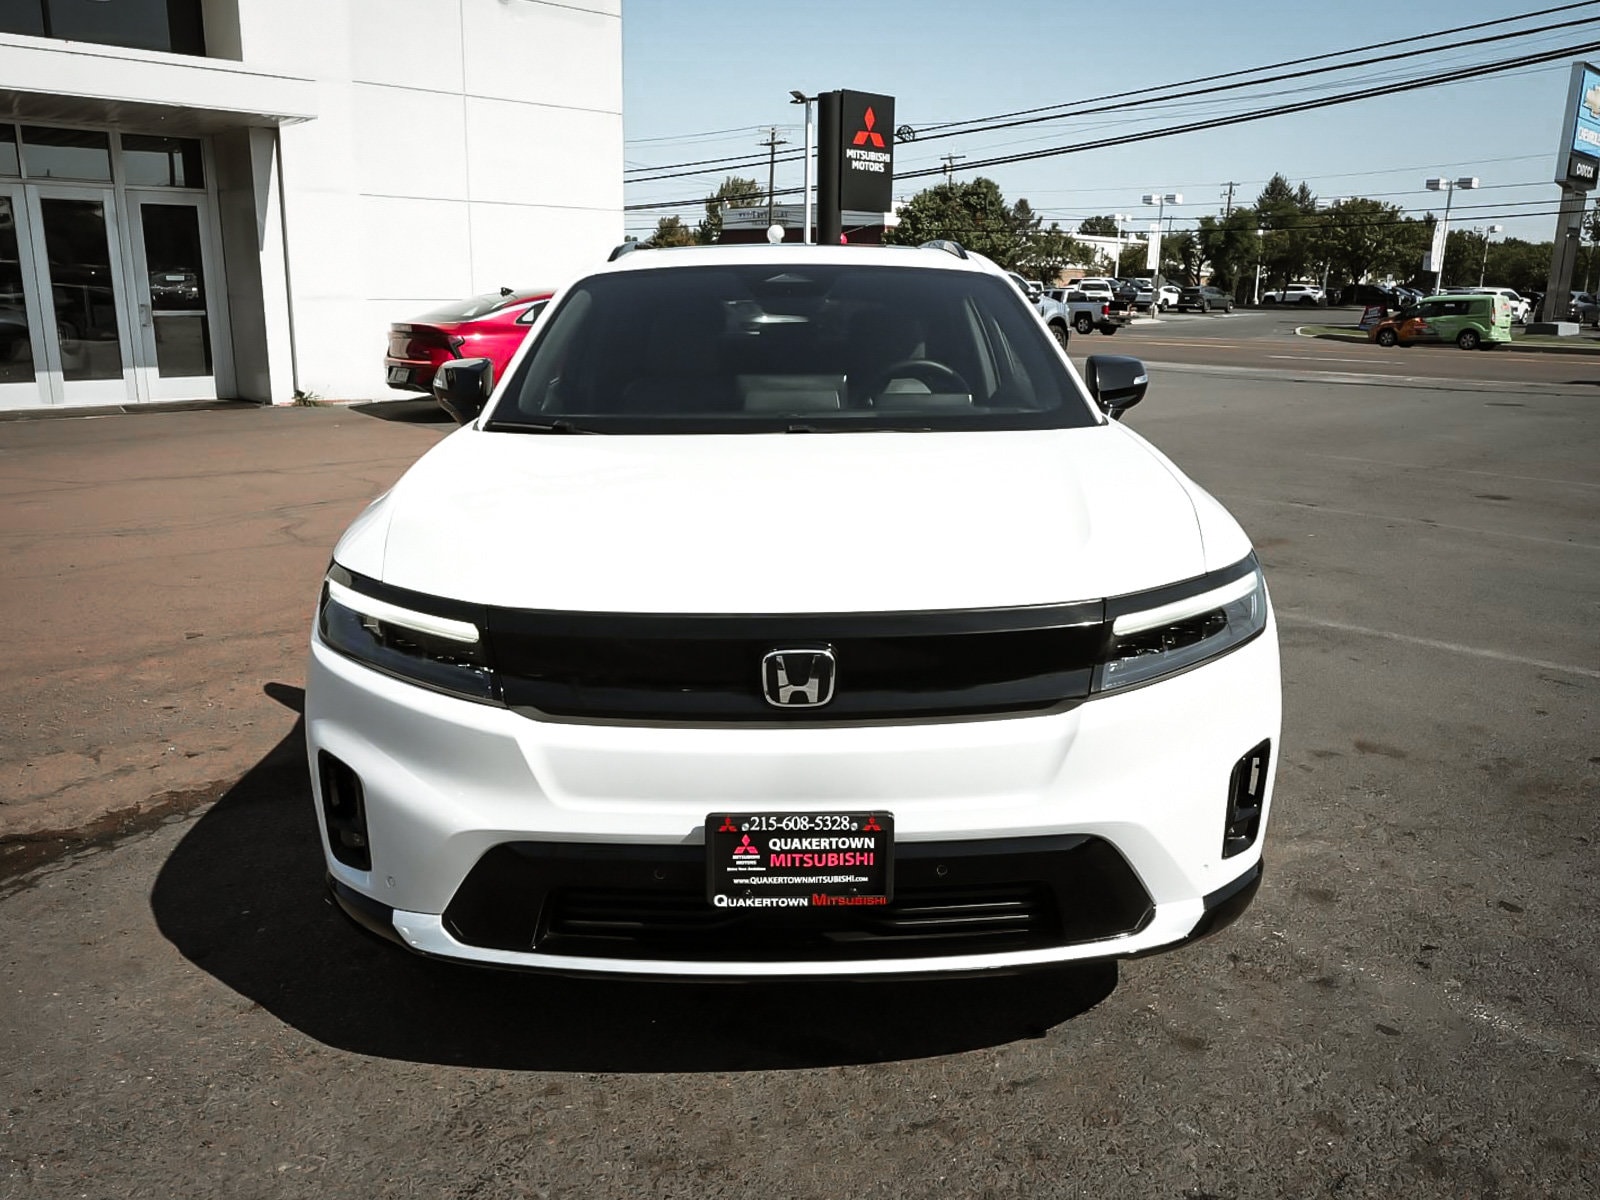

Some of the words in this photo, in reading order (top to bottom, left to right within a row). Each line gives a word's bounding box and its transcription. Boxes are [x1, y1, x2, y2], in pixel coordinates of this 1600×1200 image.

[846, 149, 891, 163] MITSUBISHI
[851, 160, 885, 173] MOTORS
[750, 816, 850, 831] 215-608-5328
[768, 837, 875, 851] QUAKERTOWN
[770, 852, 874, 867] MITSUBISHI
[713, 894, 808, 908] QUAKERTOWN
[812, 893, 888, 906] MITSUBISHI
